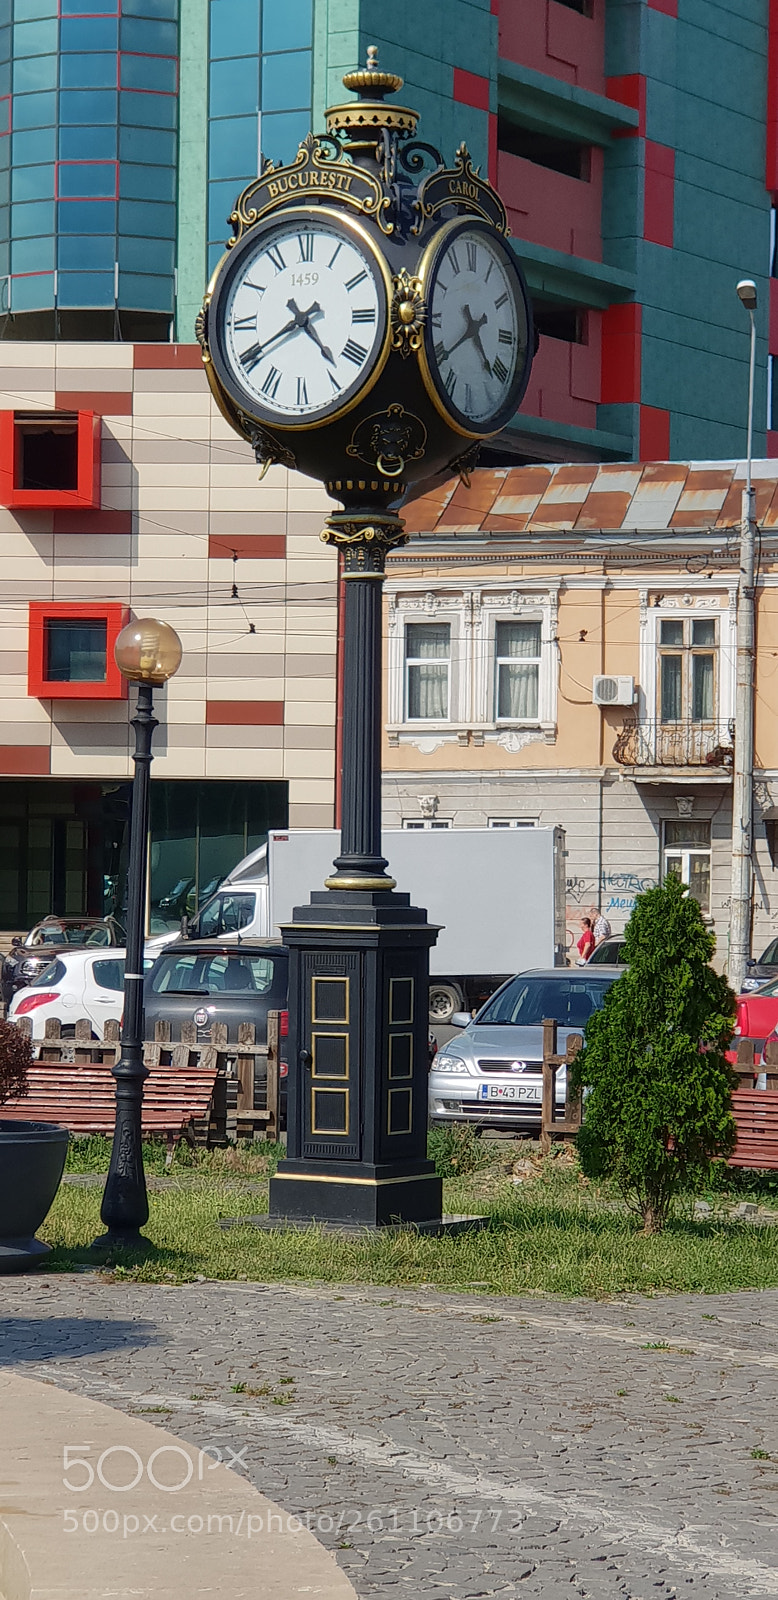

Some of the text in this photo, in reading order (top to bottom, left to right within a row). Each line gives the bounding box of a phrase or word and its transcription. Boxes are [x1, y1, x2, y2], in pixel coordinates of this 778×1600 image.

[449, 180, 480, 201] CAROL
[291, 272, 320, 287] 1459
[491, 1086, 498, 1097] B
[503, 1087, 515, 1098] 43
[519, 1088, 541, 1099] PZL
